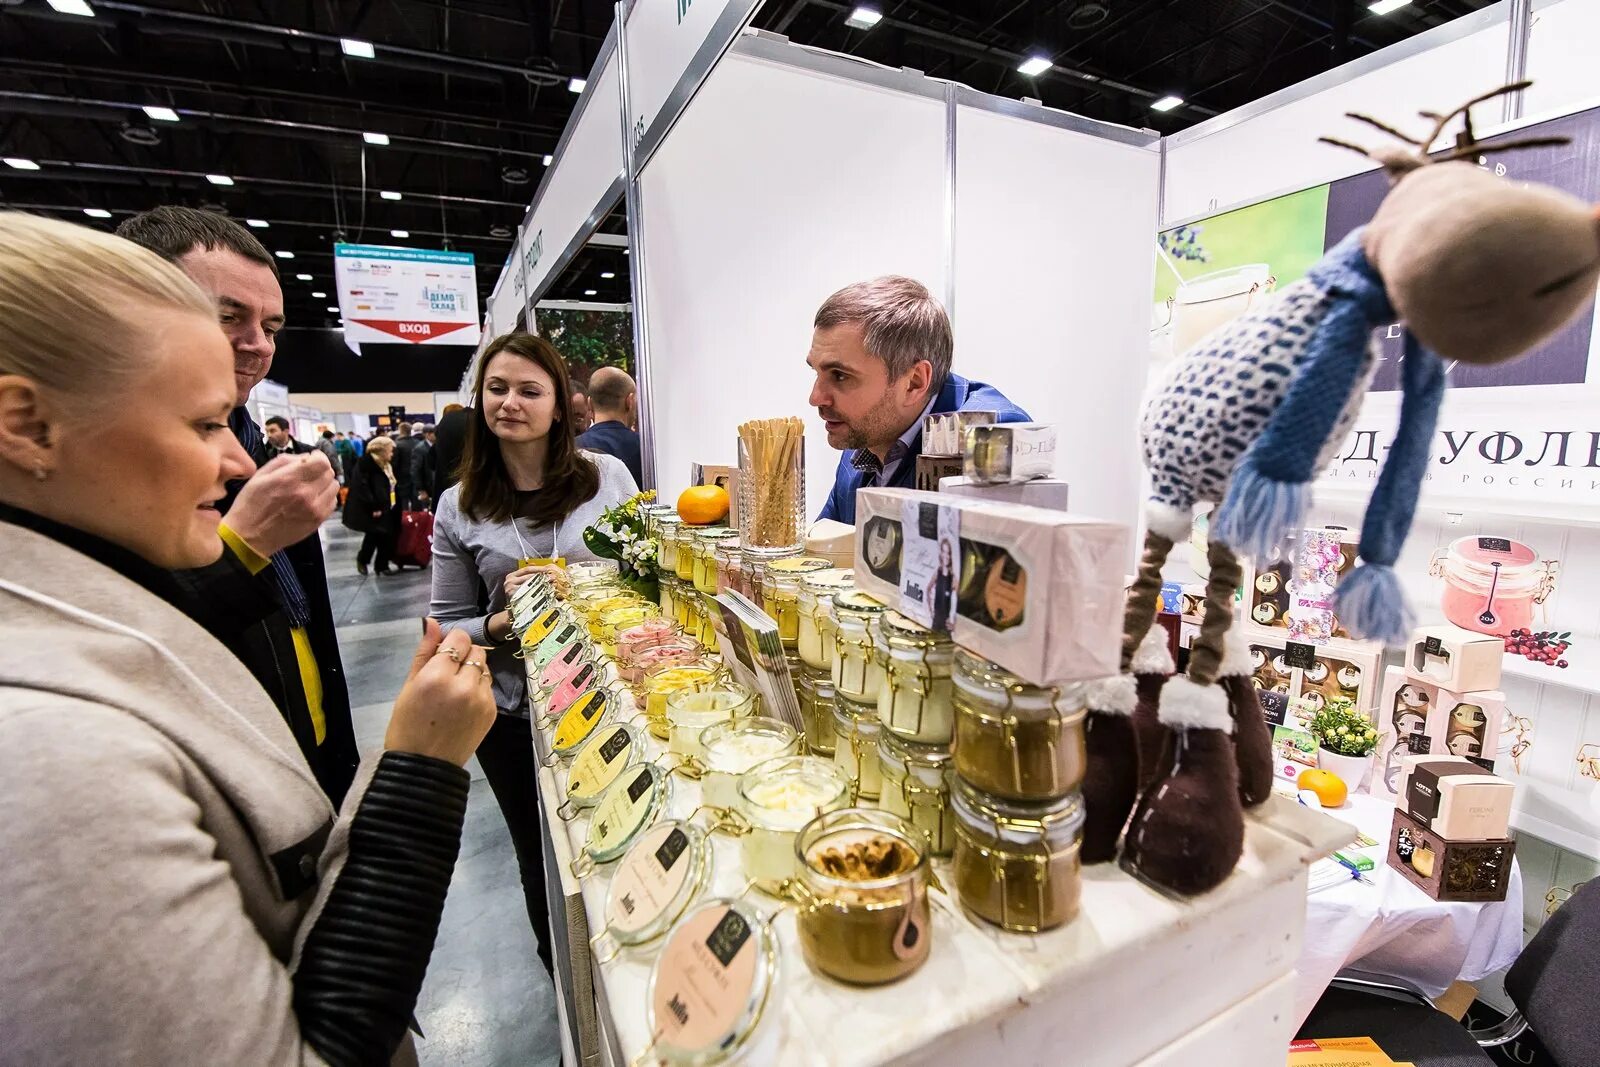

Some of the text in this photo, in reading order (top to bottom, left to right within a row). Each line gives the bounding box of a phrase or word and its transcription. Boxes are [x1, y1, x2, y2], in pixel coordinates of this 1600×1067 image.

[430, 292, 455, 302] ДЕМО
[431, 303, 456, 311] СКЛАД
[398, 323, 432, 335] ВХОД
[903, 580, 924, 603] Julia
